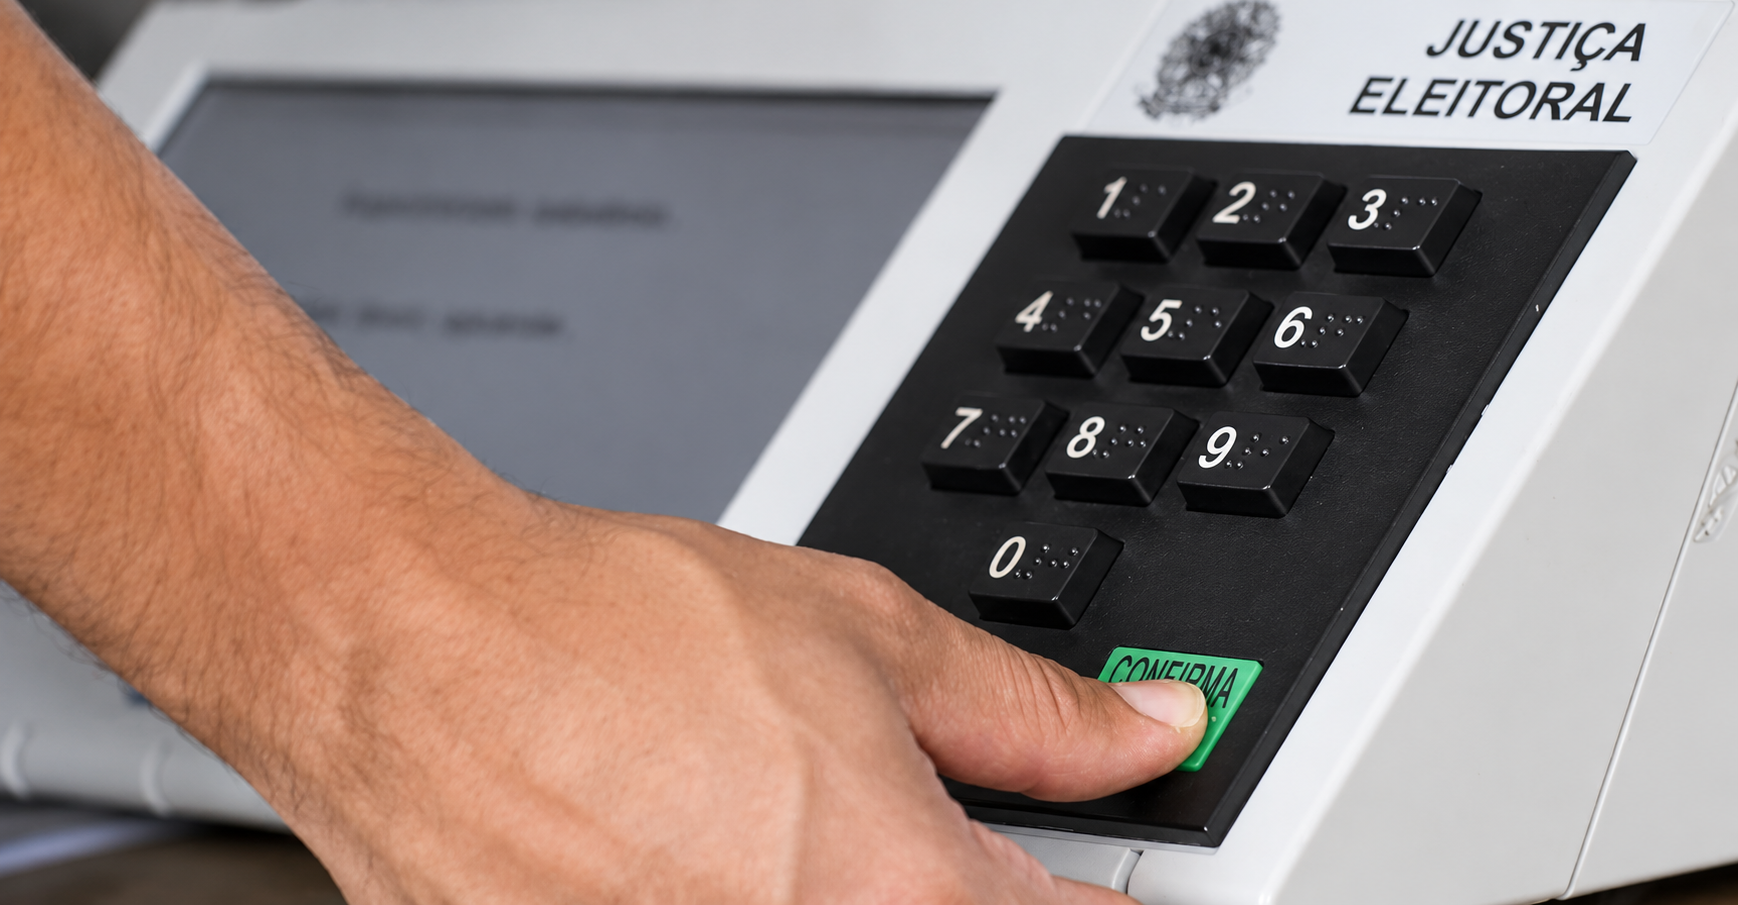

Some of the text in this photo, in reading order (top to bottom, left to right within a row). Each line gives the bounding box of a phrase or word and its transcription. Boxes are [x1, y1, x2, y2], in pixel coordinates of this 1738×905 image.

[1427, 20, 1646, 72] JUSTIÇA
[1350, 77, 1633, 123] ELEITORAL
[1097, 177, 1387, 231] 1 2 3
[1015, 291, 1313, 349] 4 5 6
[940, 407, 1237, 469] 7 8 9
[988, 535, 1027, 579] 0
